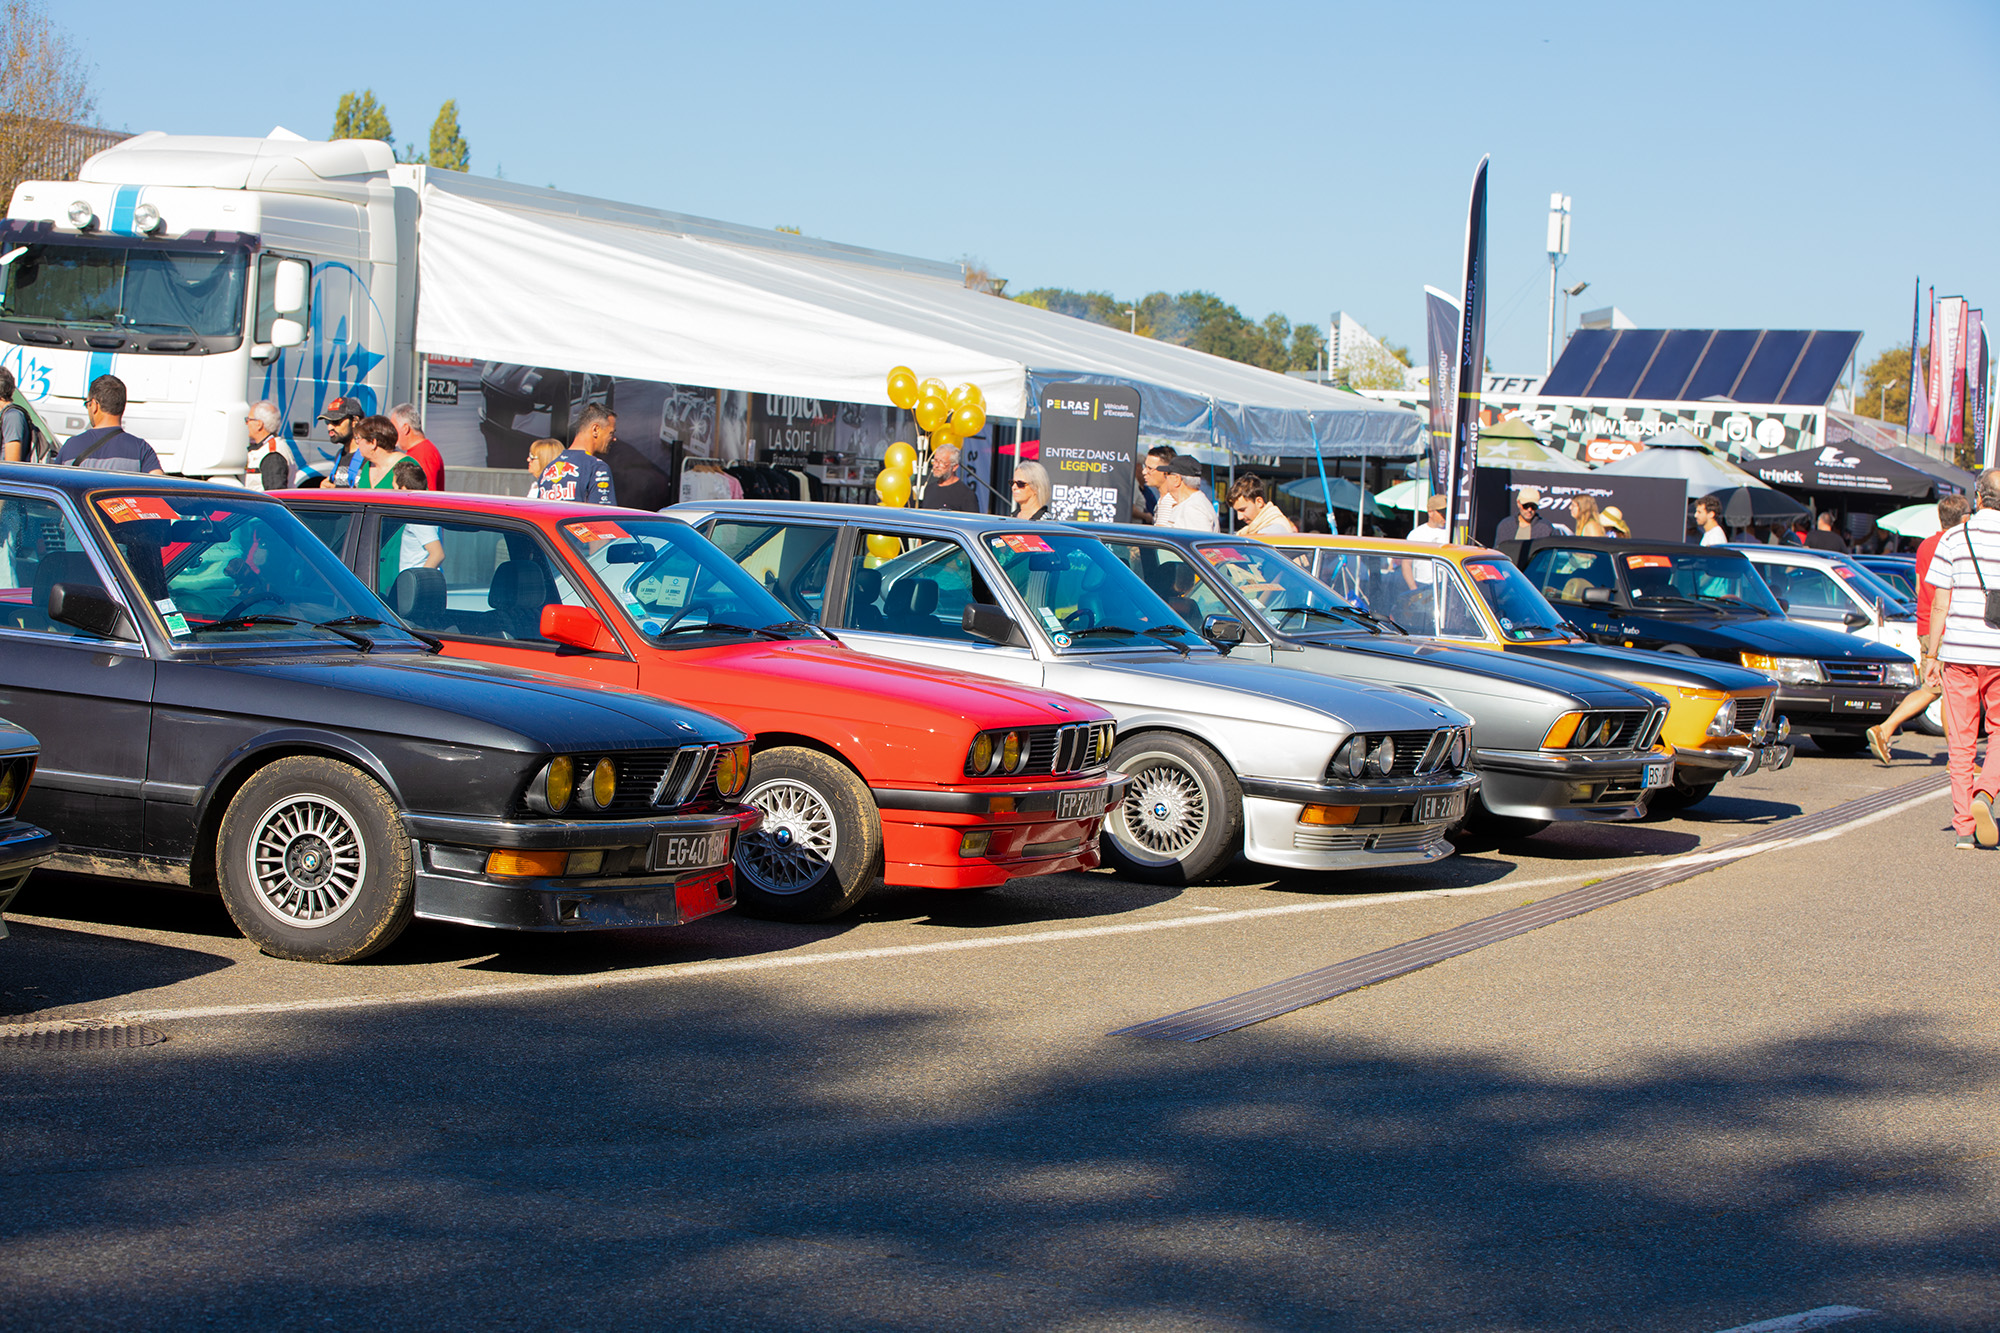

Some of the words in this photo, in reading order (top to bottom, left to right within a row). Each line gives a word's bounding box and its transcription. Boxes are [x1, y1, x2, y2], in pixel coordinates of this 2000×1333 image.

[1488, 377, 1539, 393] TFT
[1046, 399, 1090, 411] PELRAS
[1103, 402, 1129, 411] Véhicules
[768, 428, 783, 451] LA
[785, 429, 811, 452] SOIF
[1045, 447, 1085, 459] ENTREZ
[1086, 449, 1116, 461] DANS
[1117, 452, 1131, 462] LA
[1060, 460, 1108, 473] LEGENDE
[1759, 468, 1804, 484] tripick
[1538, 497, 1572, 510] 911
